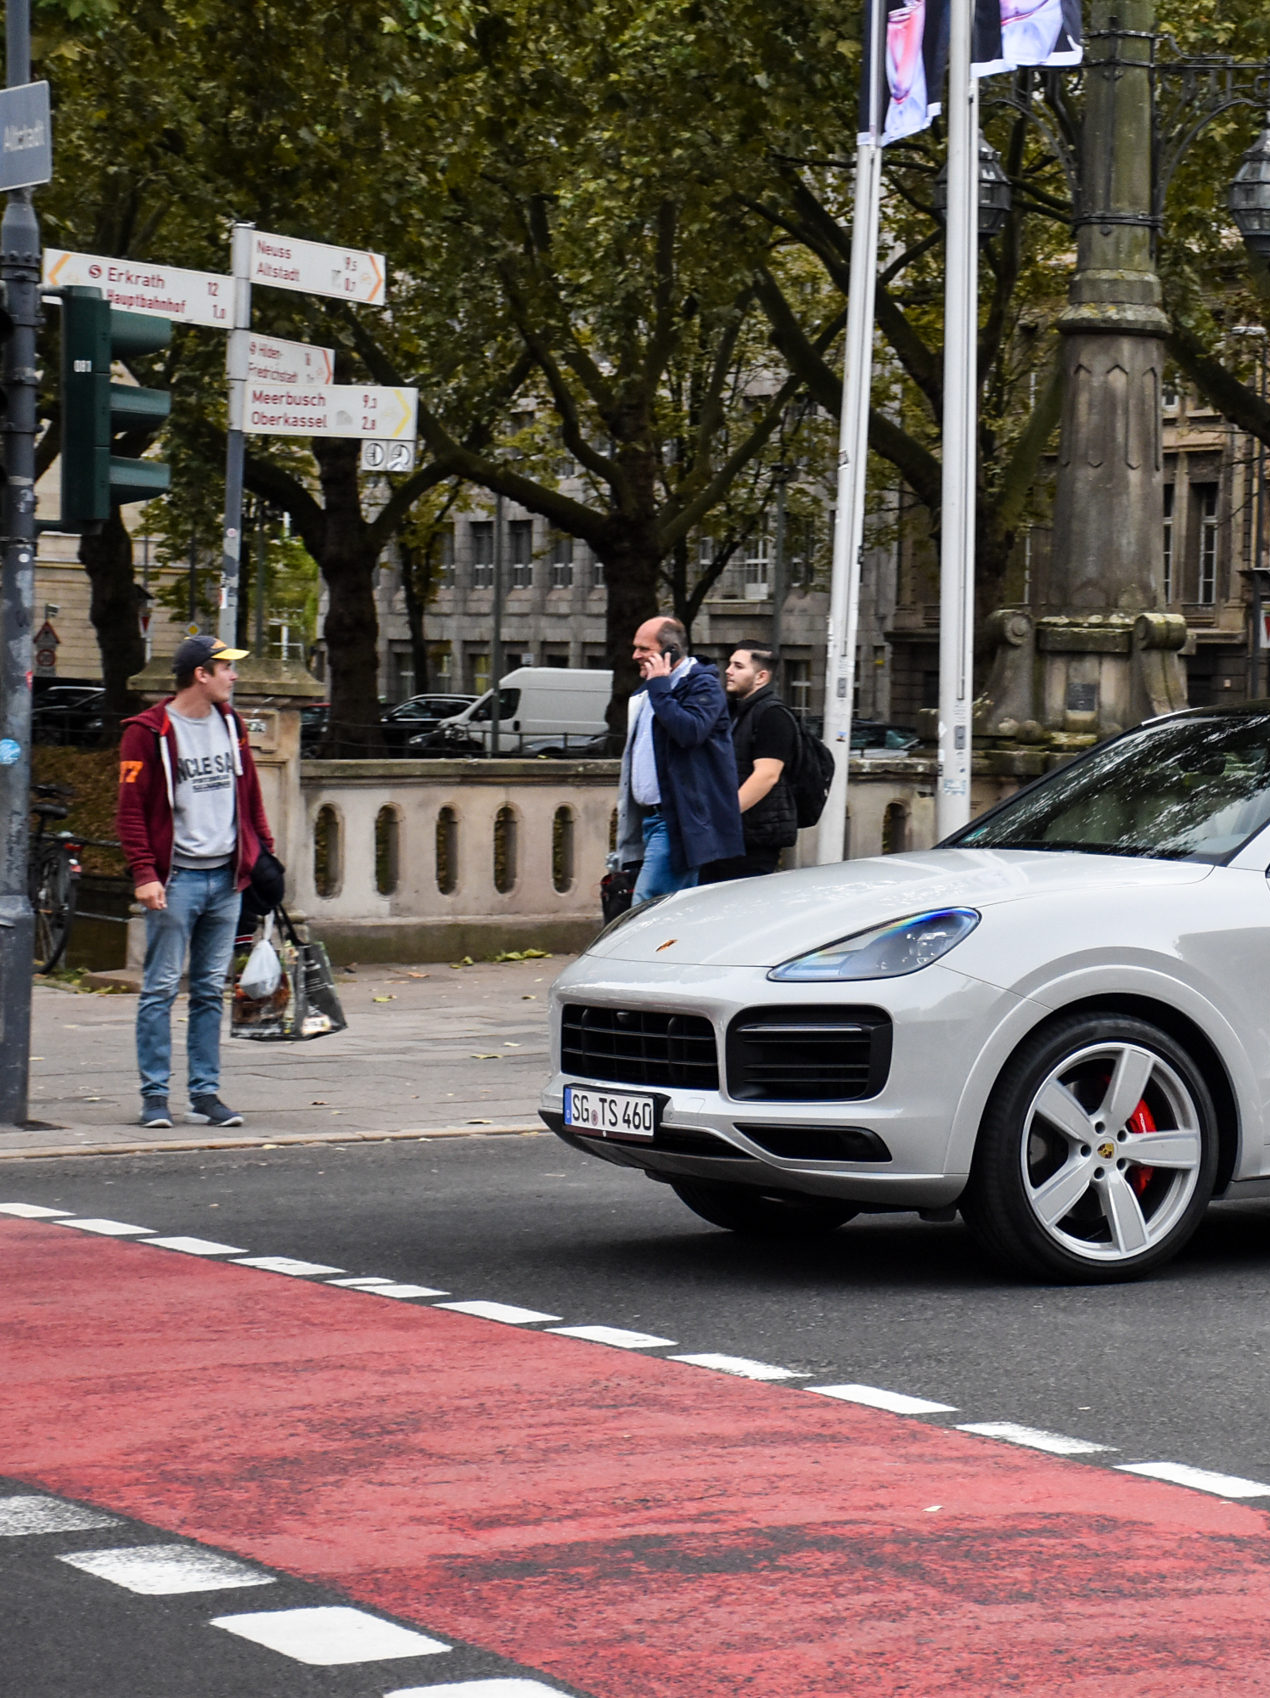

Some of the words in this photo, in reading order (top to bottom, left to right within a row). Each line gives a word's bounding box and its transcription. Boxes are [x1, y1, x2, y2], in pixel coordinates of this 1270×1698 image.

[256, 239, 292, 260] Neuss
[107, 266, 166, 289] Erkrath
[207, 281, 219, 297] 12
[256, 261, 300, 282] Altstadt
[106, 288, 187, 314] Hauptbahnhof
[251, 389, 326, 407] Meerbusch
[251, 410, 328, 428] Oberkassel
[177, 756, 212, 784] NCLE
[214, 751, 235, 774] SA
[572, 1093, 589, 1123] SG
[598, 1097, 618, 1127] TS
[622, 1100, 652, 1131] 460
